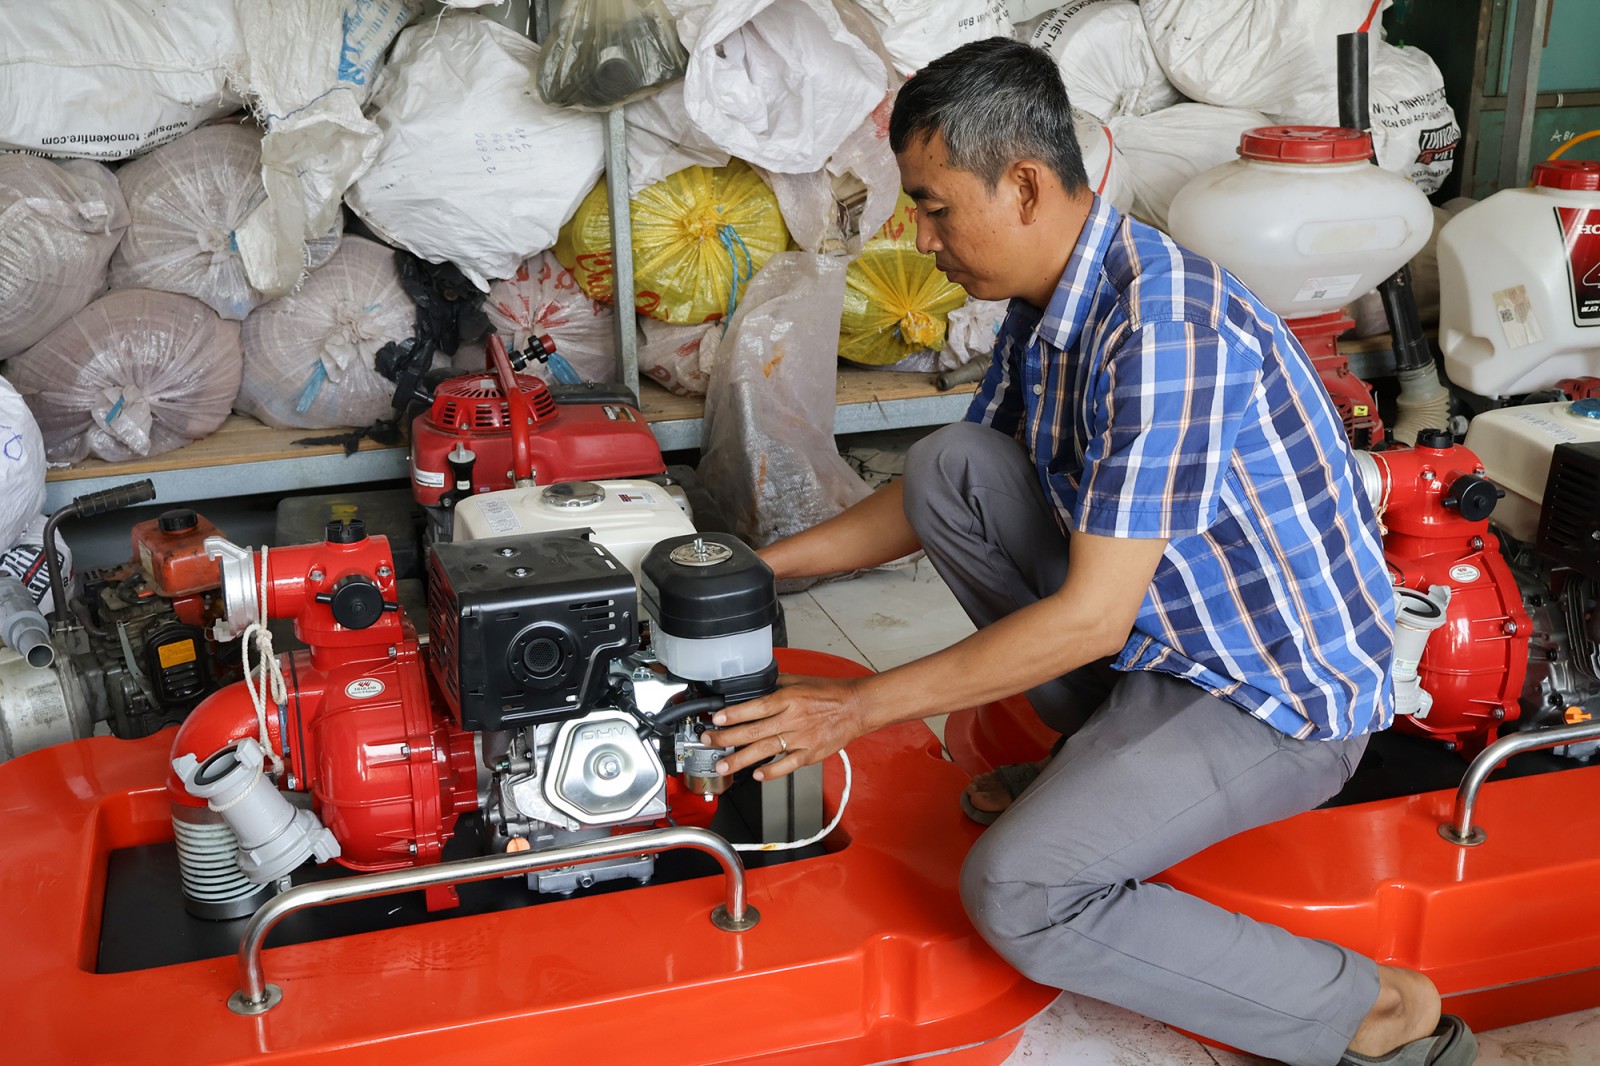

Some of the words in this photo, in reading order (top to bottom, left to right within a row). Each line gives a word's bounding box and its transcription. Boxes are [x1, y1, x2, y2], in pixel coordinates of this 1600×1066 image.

[143, 120, 189, 140] Website:
[41, 132, 140, 147] tomokenfire.com
[581, 725, 628, 742] OHV
